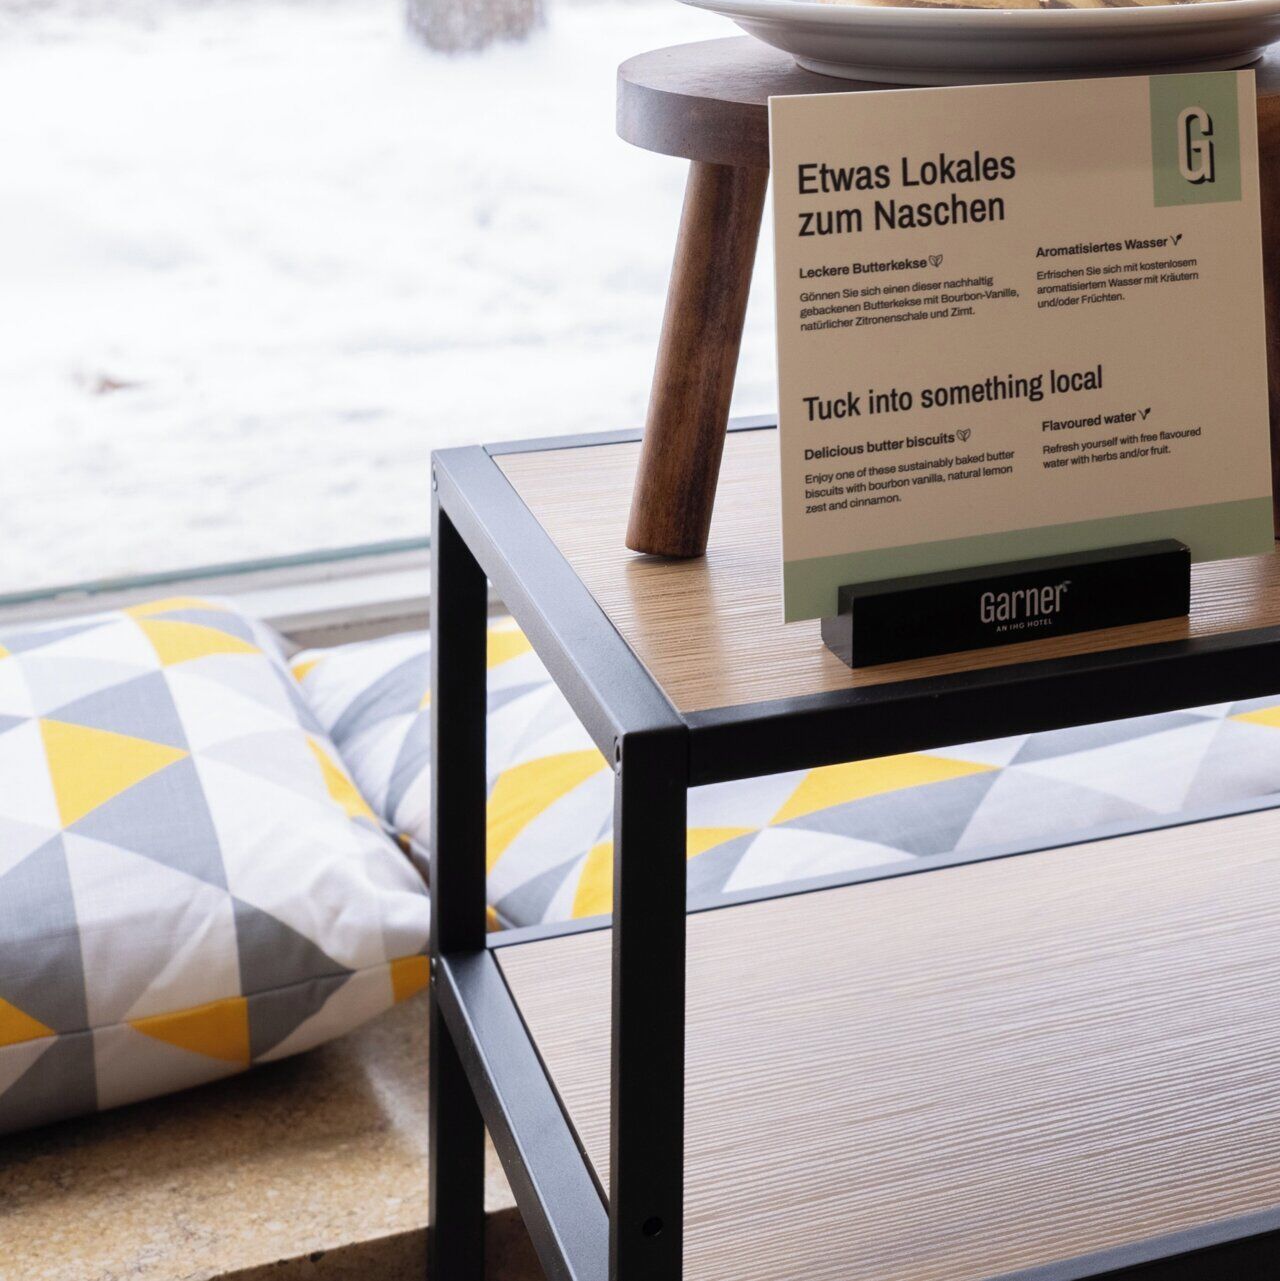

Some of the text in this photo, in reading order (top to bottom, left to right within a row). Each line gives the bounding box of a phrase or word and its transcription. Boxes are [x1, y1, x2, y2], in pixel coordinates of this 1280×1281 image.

[1177, 106, 1216, 184] G
[798, 150, 1015, 194] Etwas Lokales
[798, 193, 1004, 236] zum Naschen
[1035, 238, 1169, 258] Aromatisiertes Wasser
[798, 258, 928, 279] Leckere Butterkekse
[1036, 259, 1197, 280] Erfrischen Sie sich mit kostenlosem
[799, 276, 994, 302] Gönnen Sie sich einen dieser nachhaltig
[1036, 271, 1199, 294] aromatisiertem Wasser mit Kräutern
[799, 288, 1019, 319] gebackenen Butterkekse mit Bourbon-Vanille,
[1037, 292, 1125, 308] und/oder Früchten.
[800, 306, 975, 332] natürlicher Zitronenschale und Zimt.
[802, 363, 1102, 421] Tuck into something local
[1041, 412, 1138, 432] Flavoured water
[804, 431, 956, 460] Delicious butter biscuits
[1042, 427, 1201, 455] Refresh yourself with free flavoured
[804, 450, 1015, 485] Enjoy one of these sustainably baked butter
[1042, 445, 1171, 469] water with herbs and/or fruit.
[804, 465, 1013, 499] biscuits with bourbon vanilla, natural lemon
[805, 494, 901, 514] zest and cinnamon.
[980, 584, 1067, 624] Garner
[996, 618, 1053, 633] AN IHG HOTEL
